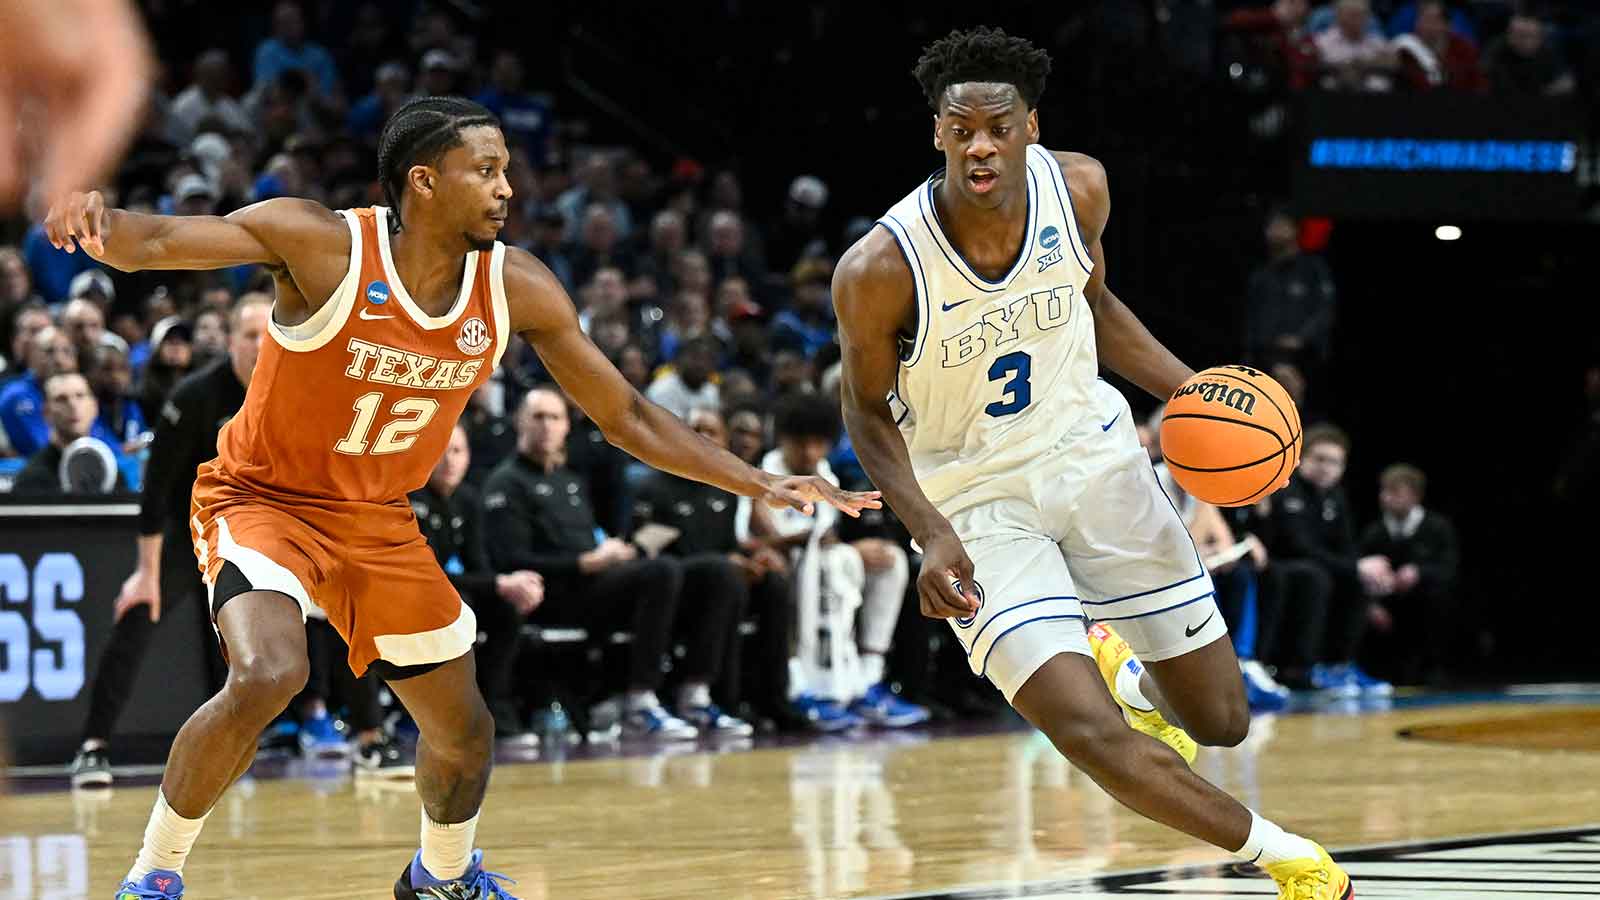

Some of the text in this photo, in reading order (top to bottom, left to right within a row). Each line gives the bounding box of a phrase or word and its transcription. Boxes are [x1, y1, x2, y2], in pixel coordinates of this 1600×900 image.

[463, 319, 486, 347] SEC
[941, 285, 1074, 368] BYU
[345, 337, 485, 390] TEXAS
[985, 351, 1032, 418] 3
[333, 392, 440, 456] 12
[1173, 382, 1256, 416] Wilson
